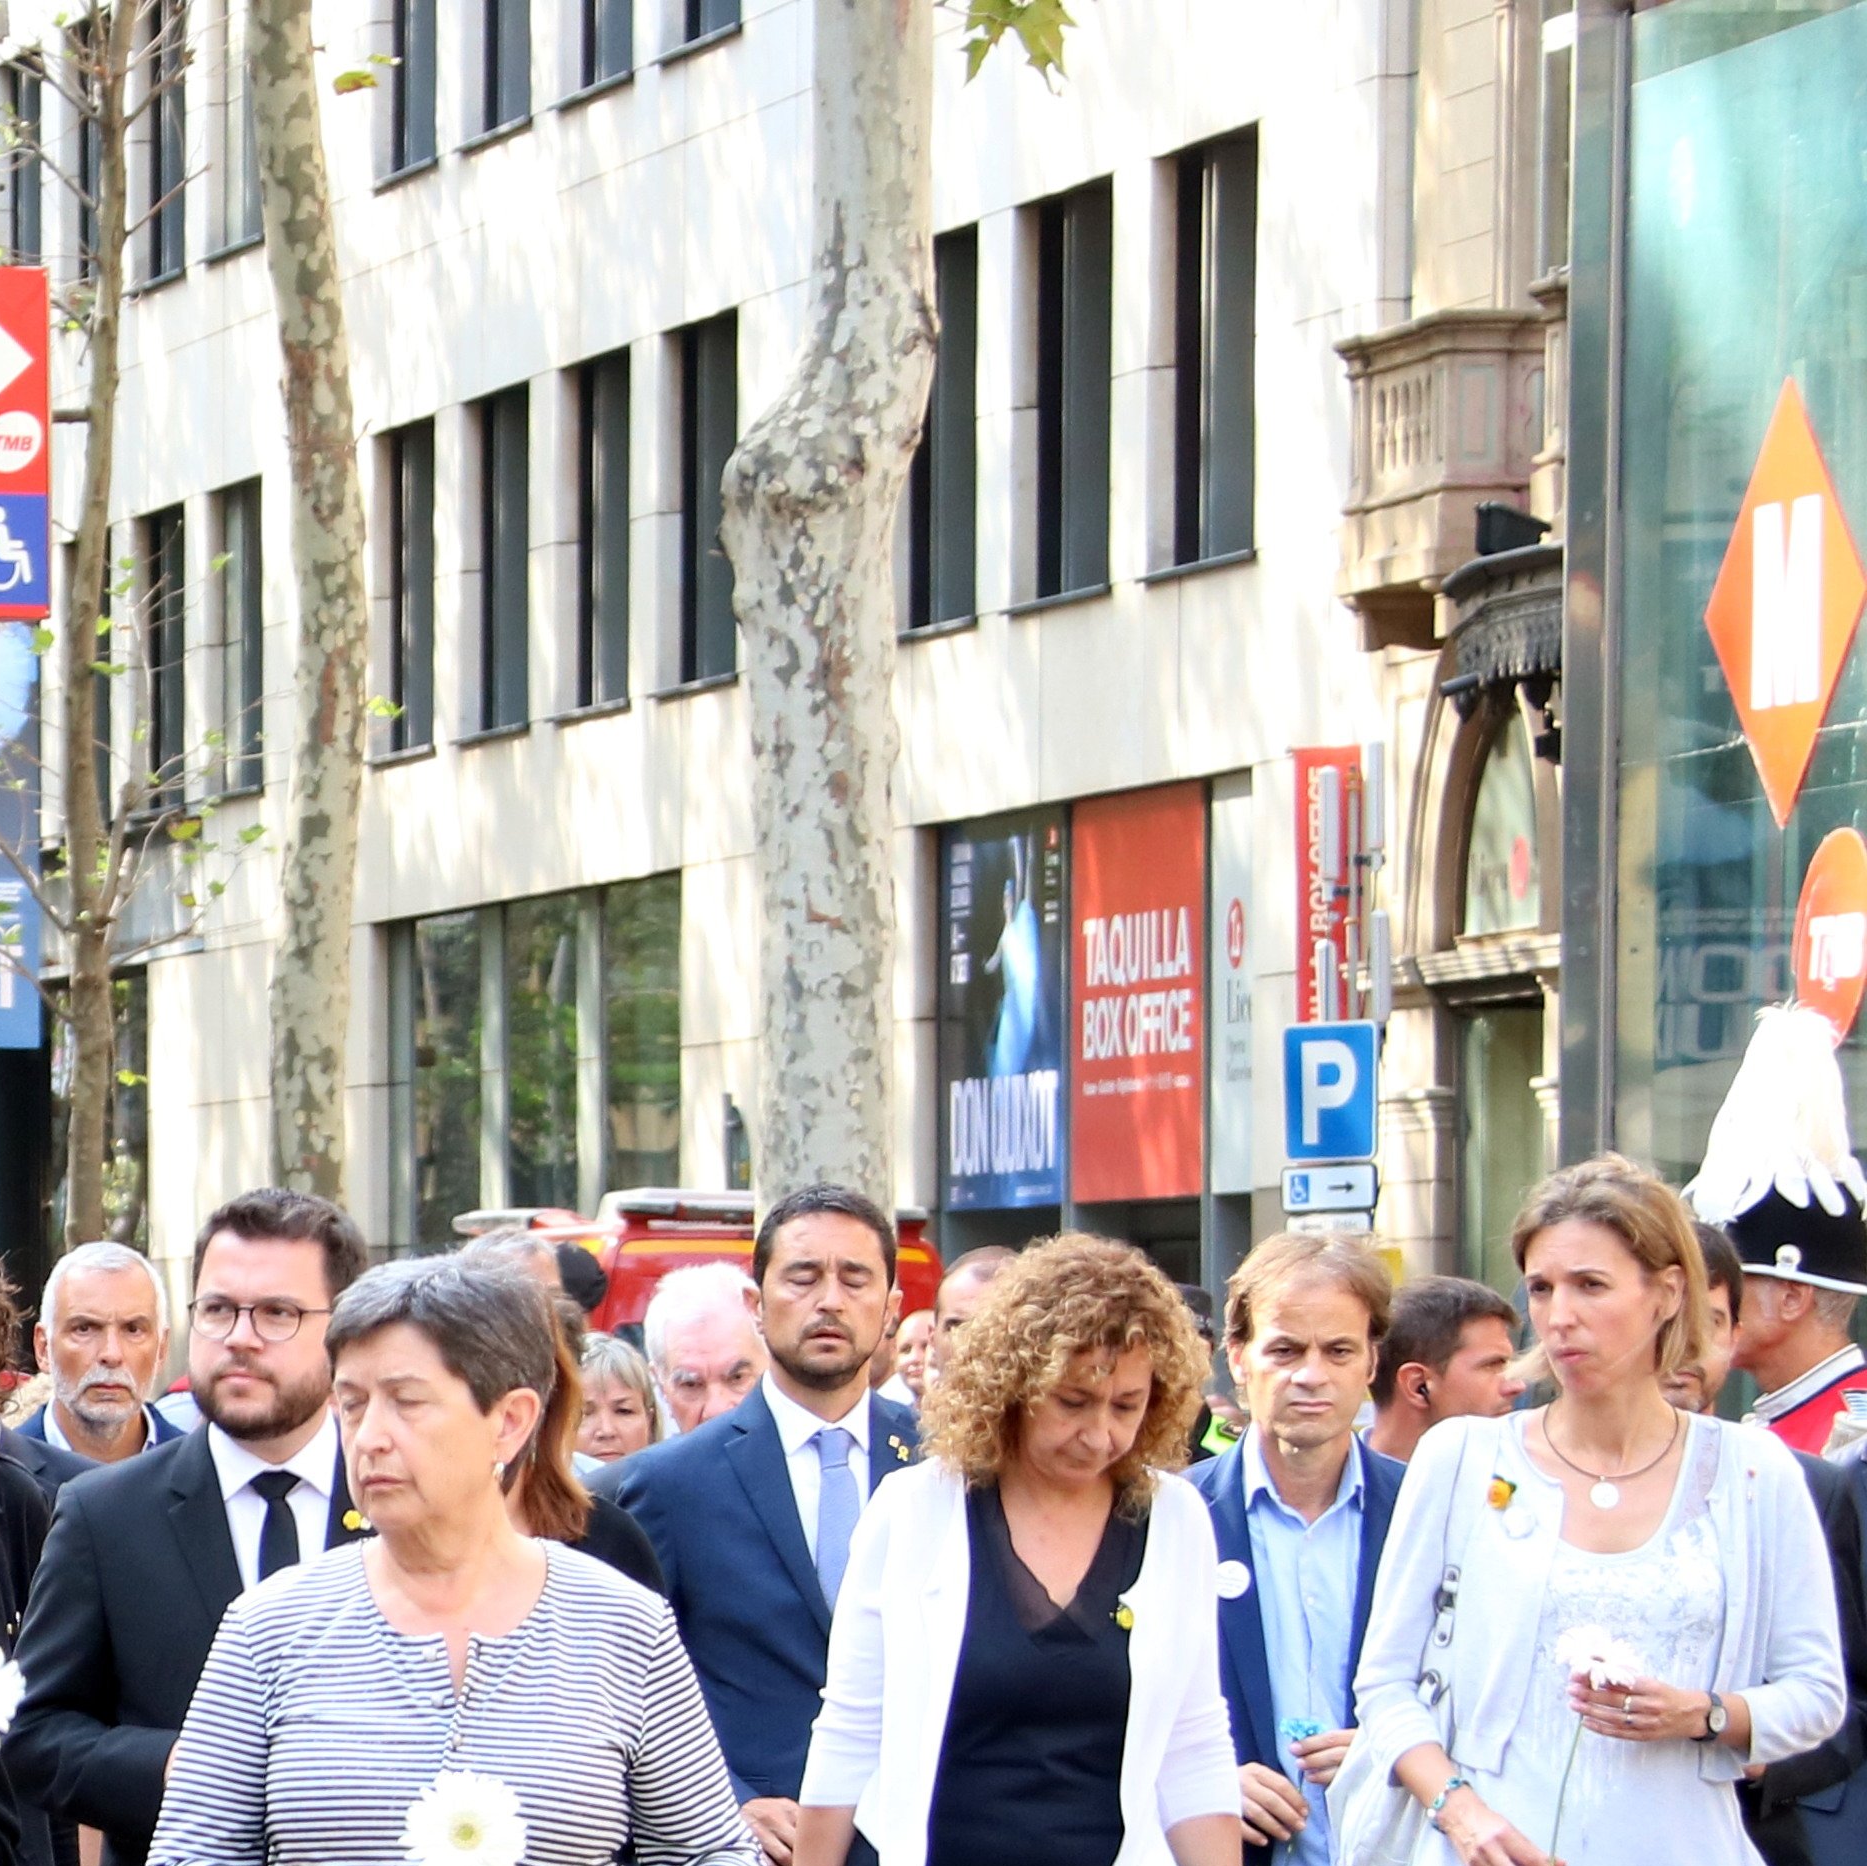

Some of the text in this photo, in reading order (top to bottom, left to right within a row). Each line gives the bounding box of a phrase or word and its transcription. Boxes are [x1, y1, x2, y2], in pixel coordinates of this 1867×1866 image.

[1751, 493, 1822, 710] M
[1082, 906, 1192, 988] TAQUILLA
[1082, 987, 1193, 1061] BOX OFFICE
[950, 1070, 1059, 1176] DON QUIXOT
[1301, 1039, 1357, 1146] P
